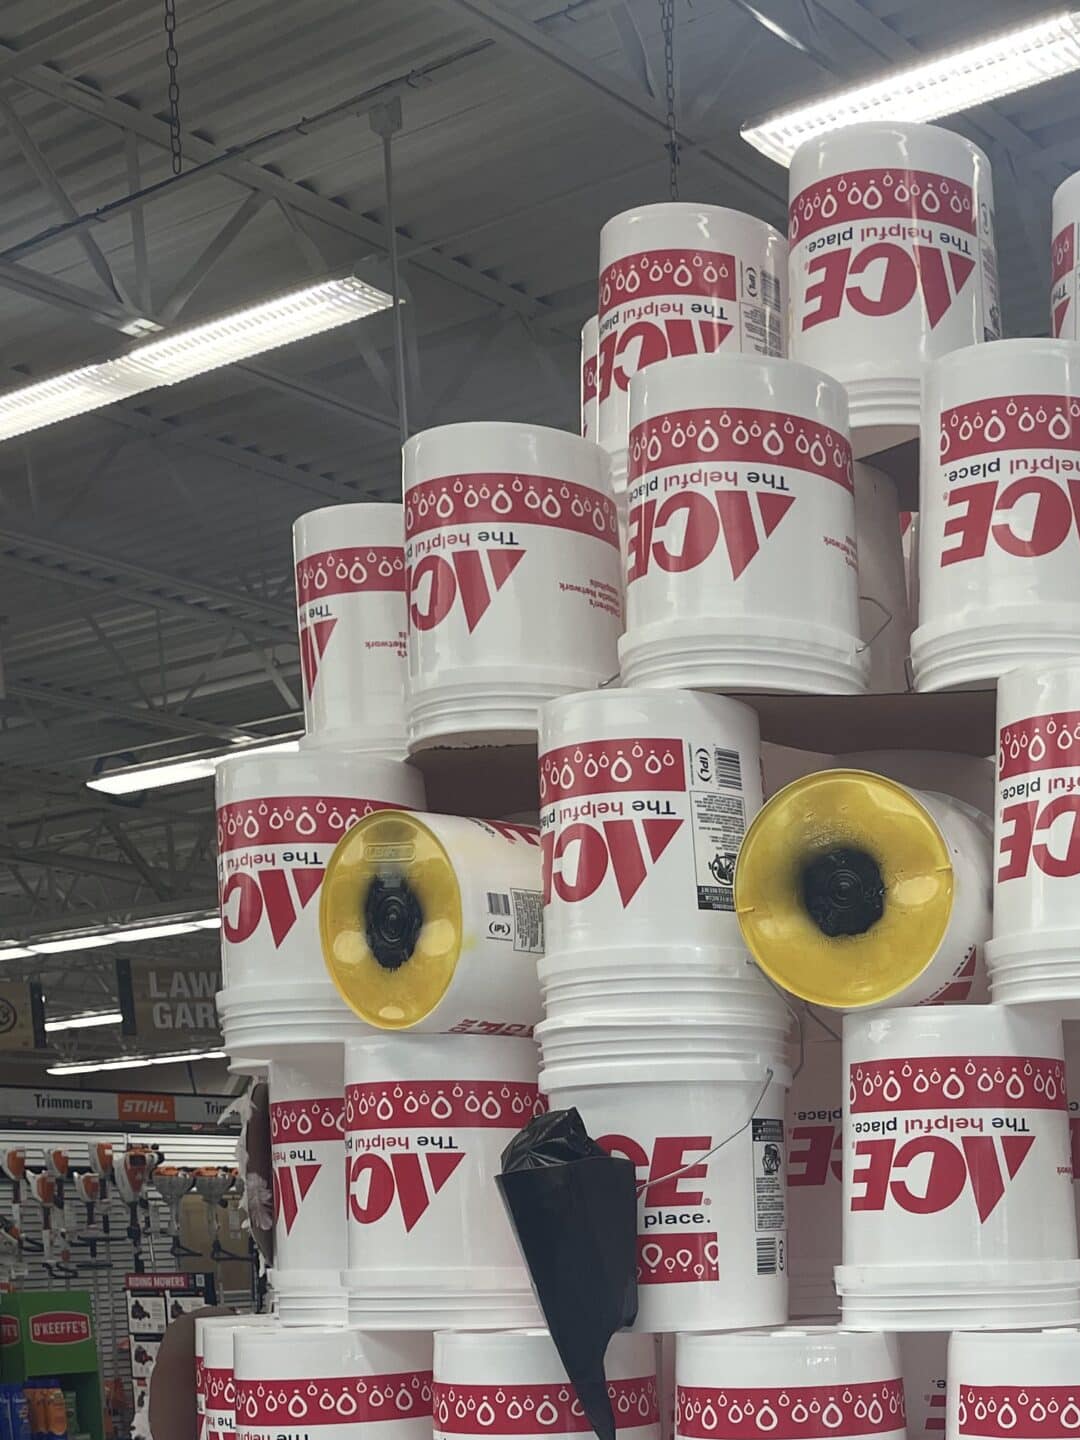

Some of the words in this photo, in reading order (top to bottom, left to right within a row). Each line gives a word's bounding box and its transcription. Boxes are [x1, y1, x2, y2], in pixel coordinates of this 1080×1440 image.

[809, 227, 853, 252] place.
[861, 224, 932, 243] helpful
[940, 233, 971, 255] The
[801, 242, 977, 335] ACE
[624, 302, 683, 323] helpful
[691, 304, 728, 320] The
[945, 458, 1000, 481] place.
[664, 469, 737, 492] helpful
[747, 472, 789, 491] The
[415, 533, 470, 557] helpful
[478, 532, 519, 545] The
[560, 801, 623, 824] helpful
[632, 801, 676, 815] The
[283, 852, 323, 864] The
[34, 1094, 93, 1110] Trimmers
[122, 1100, 168, 1114] STIHL
[856, 1117, 897, 1135] place.
[905, 1115, 983, 1134] helpful
[992, 1118, 1030, 1132] The
[417, 1136, 458, 1149] The
[851, 1134, 1035, 1224] ACE
[644, 1212, 711, 1228] place.
[128, 1277, 153, 1287] RIDING
[157, 1277, 184, 1287] MOWERS
[34, 1323, 87, 1336] O'KEEFFE'S
